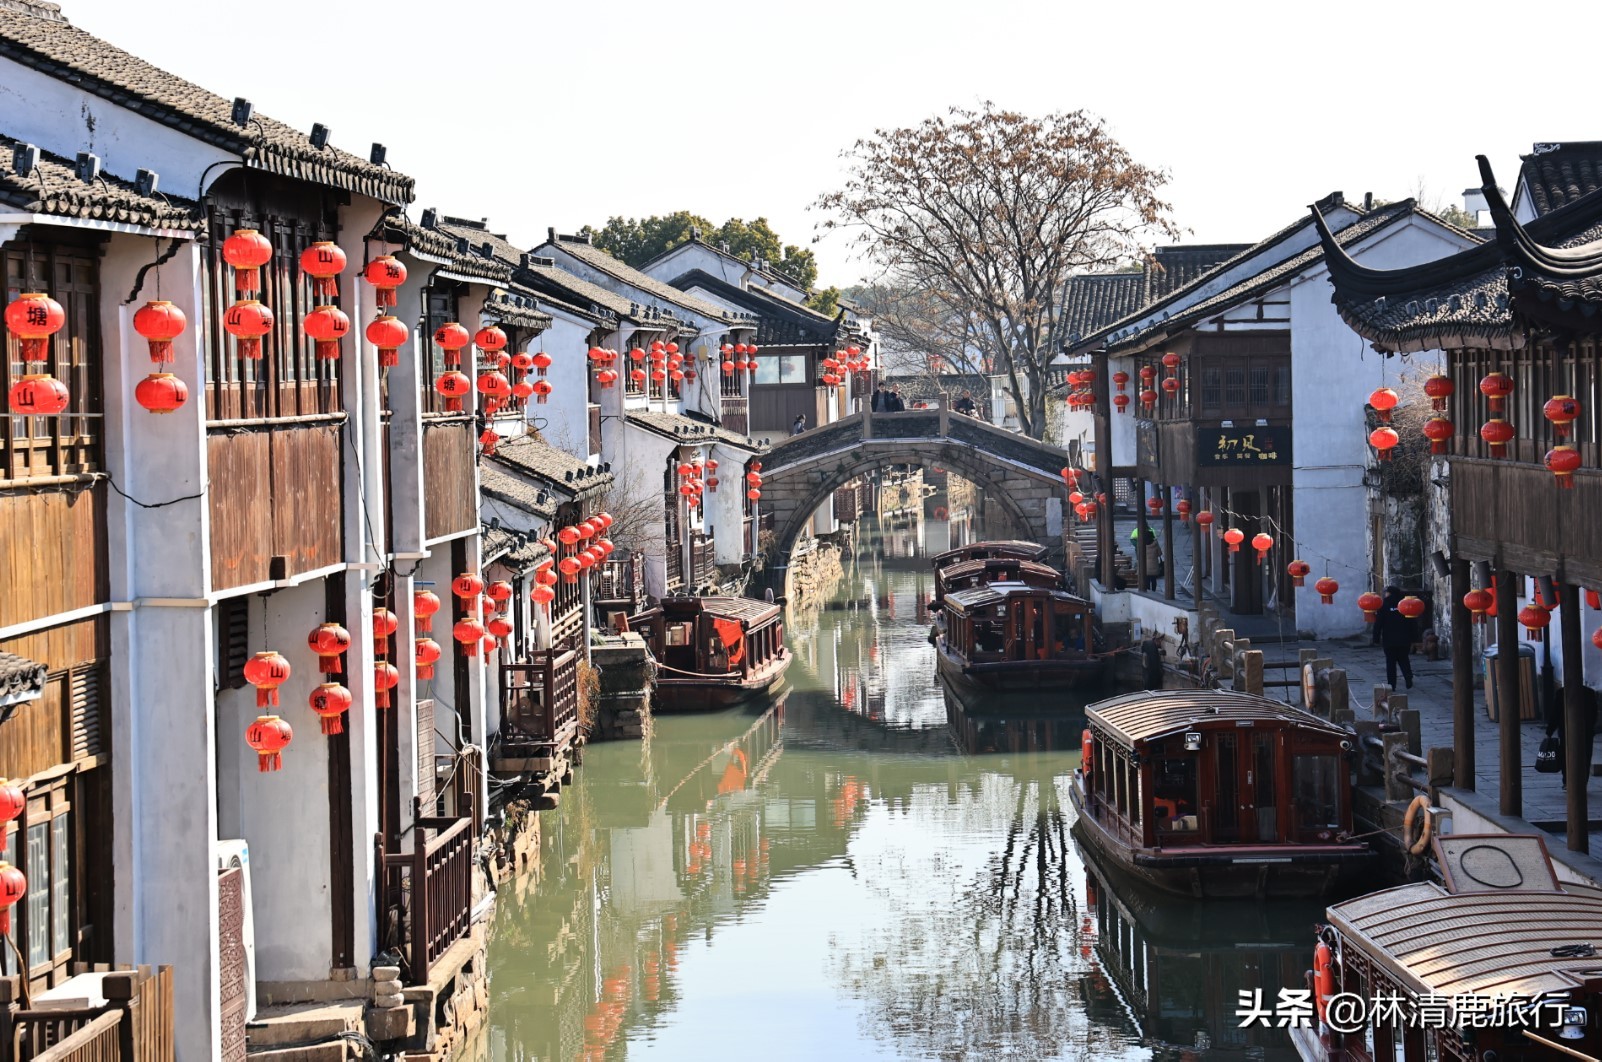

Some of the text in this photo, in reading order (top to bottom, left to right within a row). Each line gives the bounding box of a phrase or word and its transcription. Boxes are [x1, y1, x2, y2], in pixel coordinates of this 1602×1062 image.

[319, 251, 333, 264] 山
[27, 306, 47, 326] 塘
[228, 310, 241, 325] 山
[334, 319, 345, 331] 山
[486, 333, 496, 345] 山
[487, 378, 498, 389] 山
[18, 388, 34, 407] 山
[1218, 434, 1261, 452] 初见
[460, 580, 471, 592] 山
[271, 666, 283, 678] 山
[251, 727, 262, 743] 山
